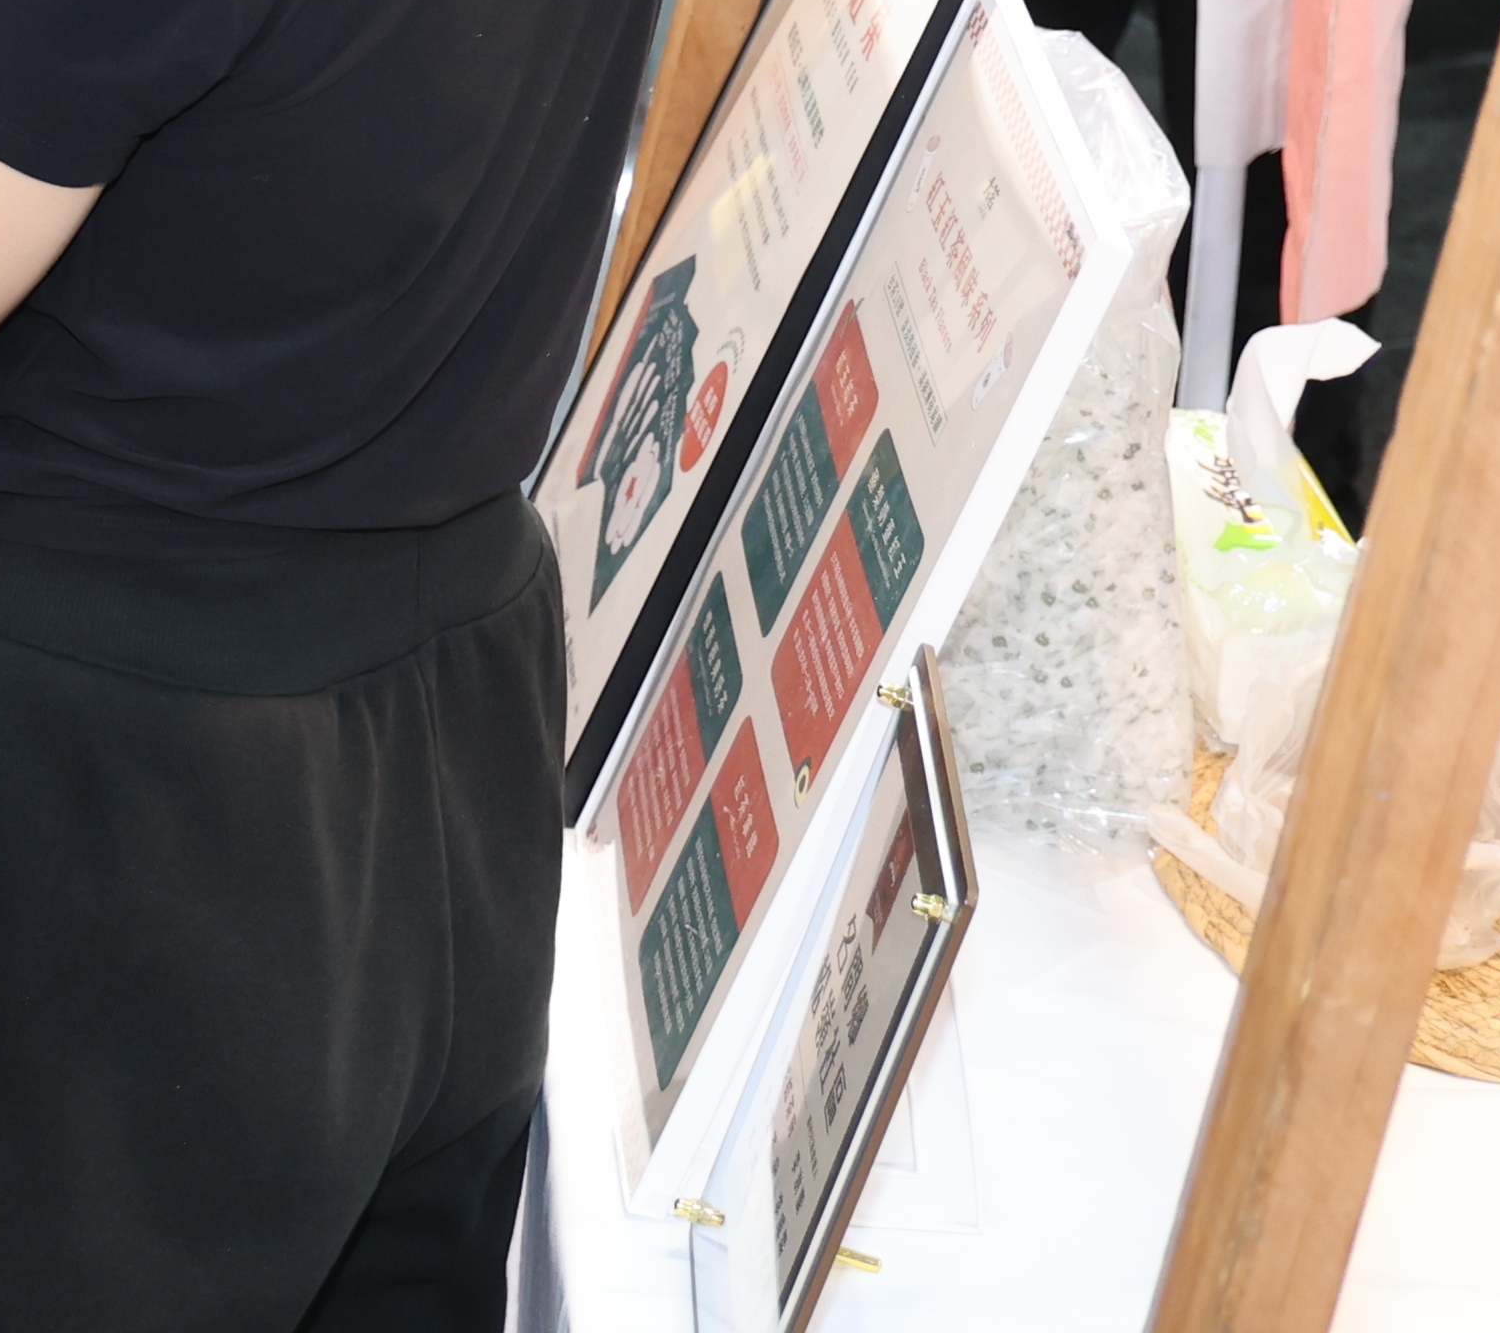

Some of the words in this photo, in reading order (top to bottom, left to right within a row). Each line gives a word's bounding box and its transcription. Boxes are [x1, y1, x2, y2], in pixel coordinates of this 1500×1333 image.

[844, 58, 859, 98] TEA
[916, 255, 934, 296] Black
[926, 284, 940, 316] Tea
[933, 304, 954, 356] Flavors
[926, 170, 996, 353] 紅玉紅茶風味系列
[811, 953, 847, 1135] 松嶺社區
[837, 913, 869, 1047] 名間鄉
